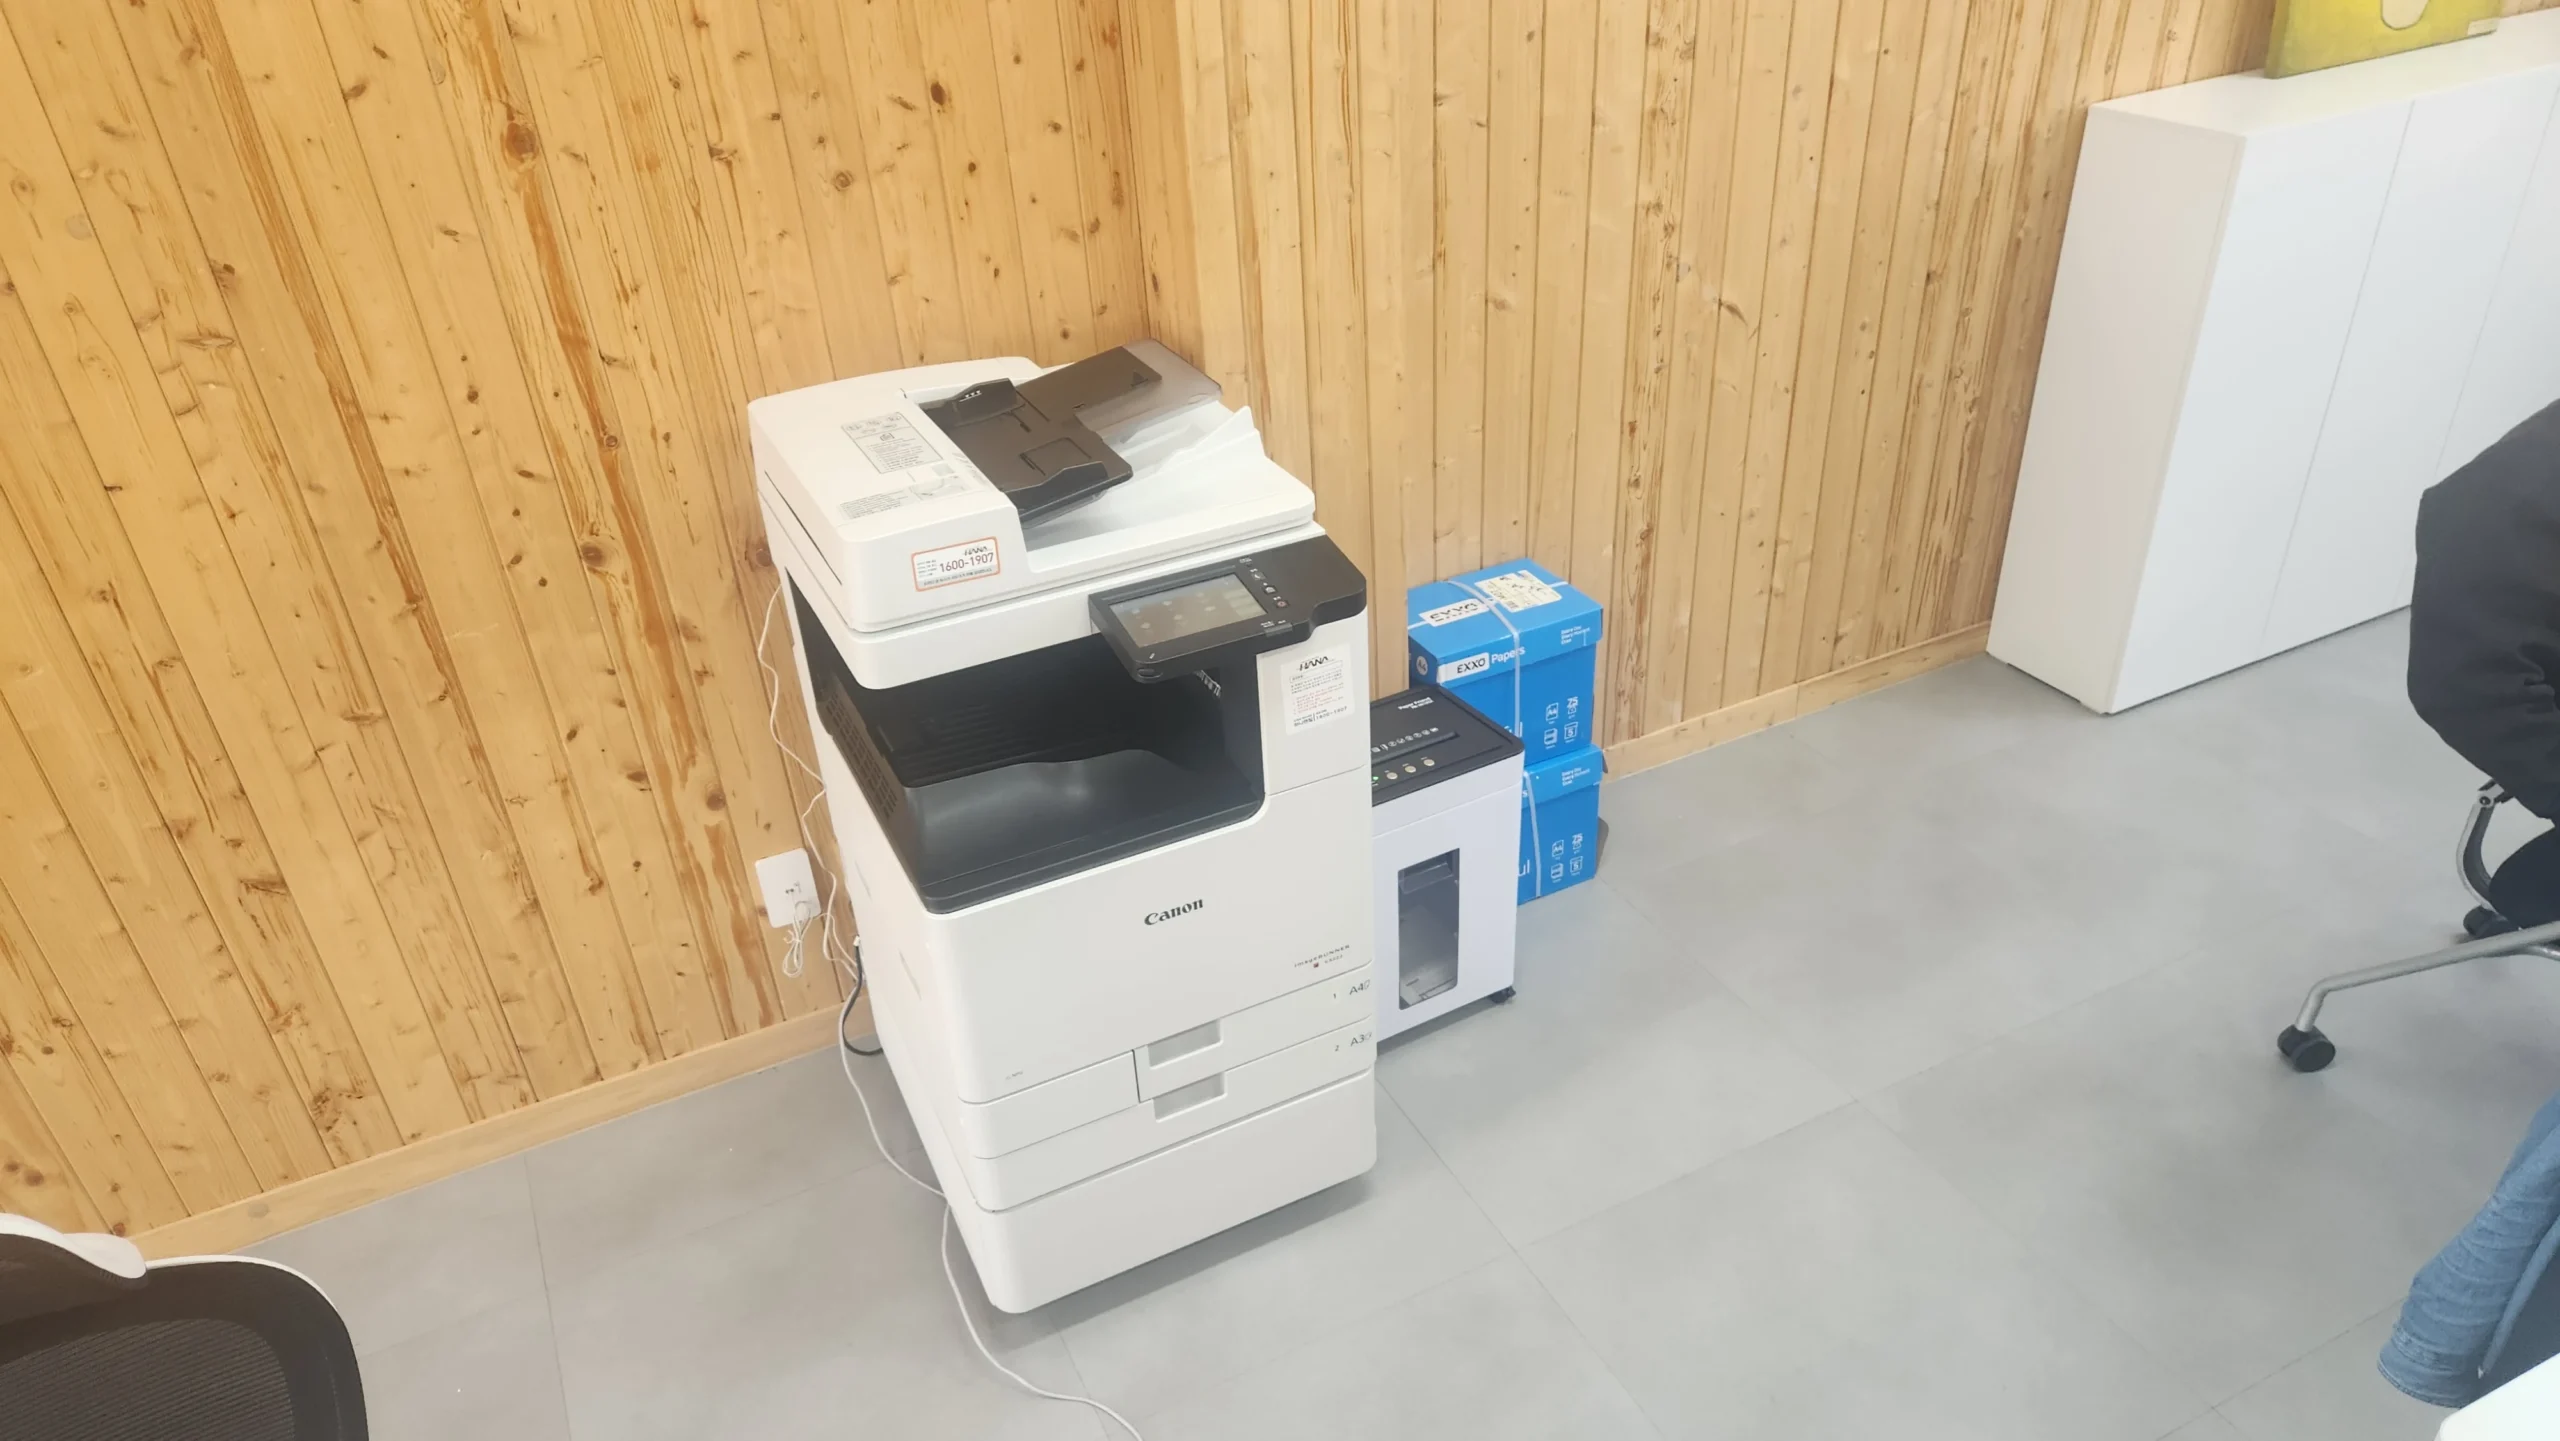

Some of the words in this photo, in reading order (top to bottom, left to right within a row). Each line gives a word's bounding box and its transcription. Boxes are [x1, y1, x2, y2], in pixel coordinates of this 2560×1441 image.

[939, 552, 994, 573] 1600-1907
[1456, 657, 1486, 674] EXXO
[1491, 646, 1526, 664] Papers
[1144, 899, 1203, 926] Canon
[1349, 983, 1364, 995] A4
[1350, 1034, 1365, 1047] A3
